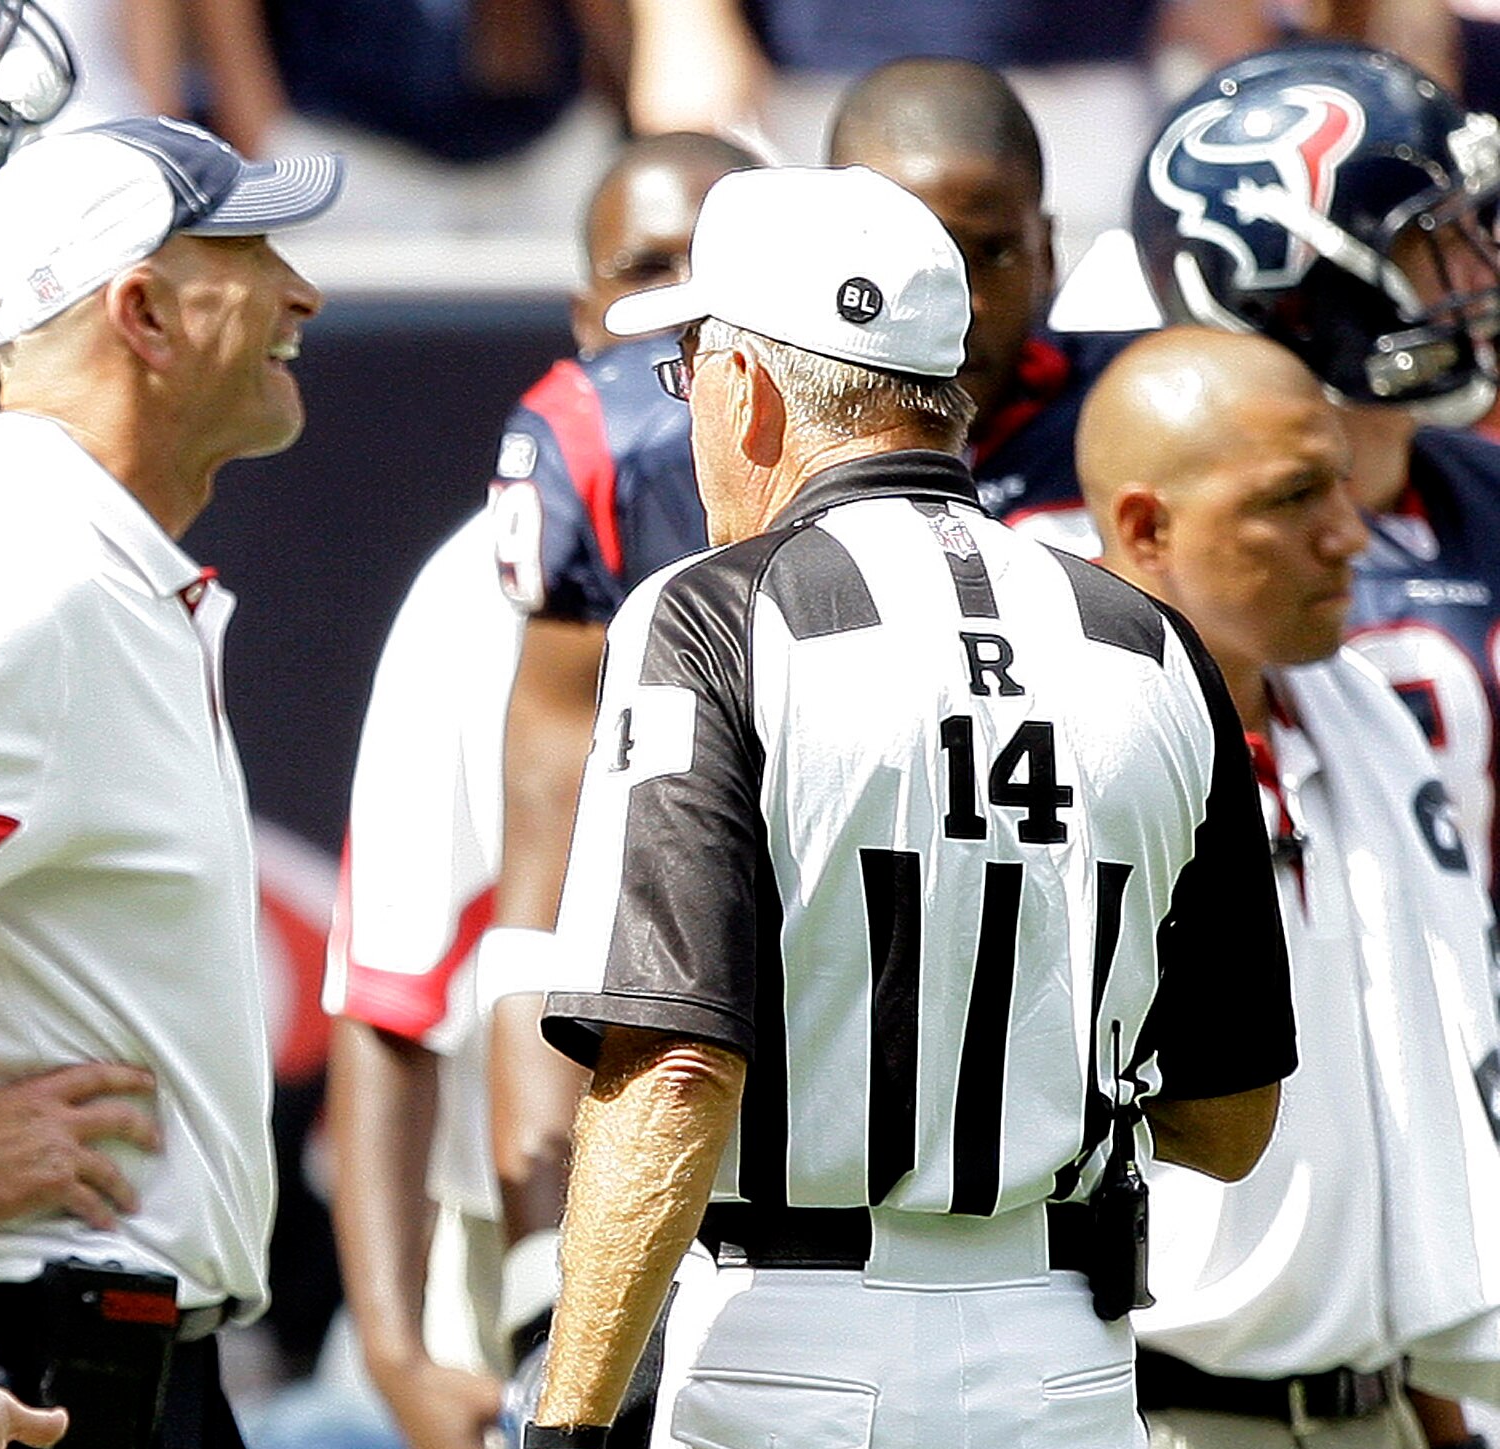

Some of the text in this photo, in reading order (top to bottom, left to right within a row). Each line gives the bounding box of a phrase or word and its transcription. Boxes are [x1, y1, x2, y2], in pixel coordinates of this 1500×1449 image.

[842, 285, 876, 314] BL
[959, 631, 1026, 696] R
[940, 715, 1074, 845] 14
